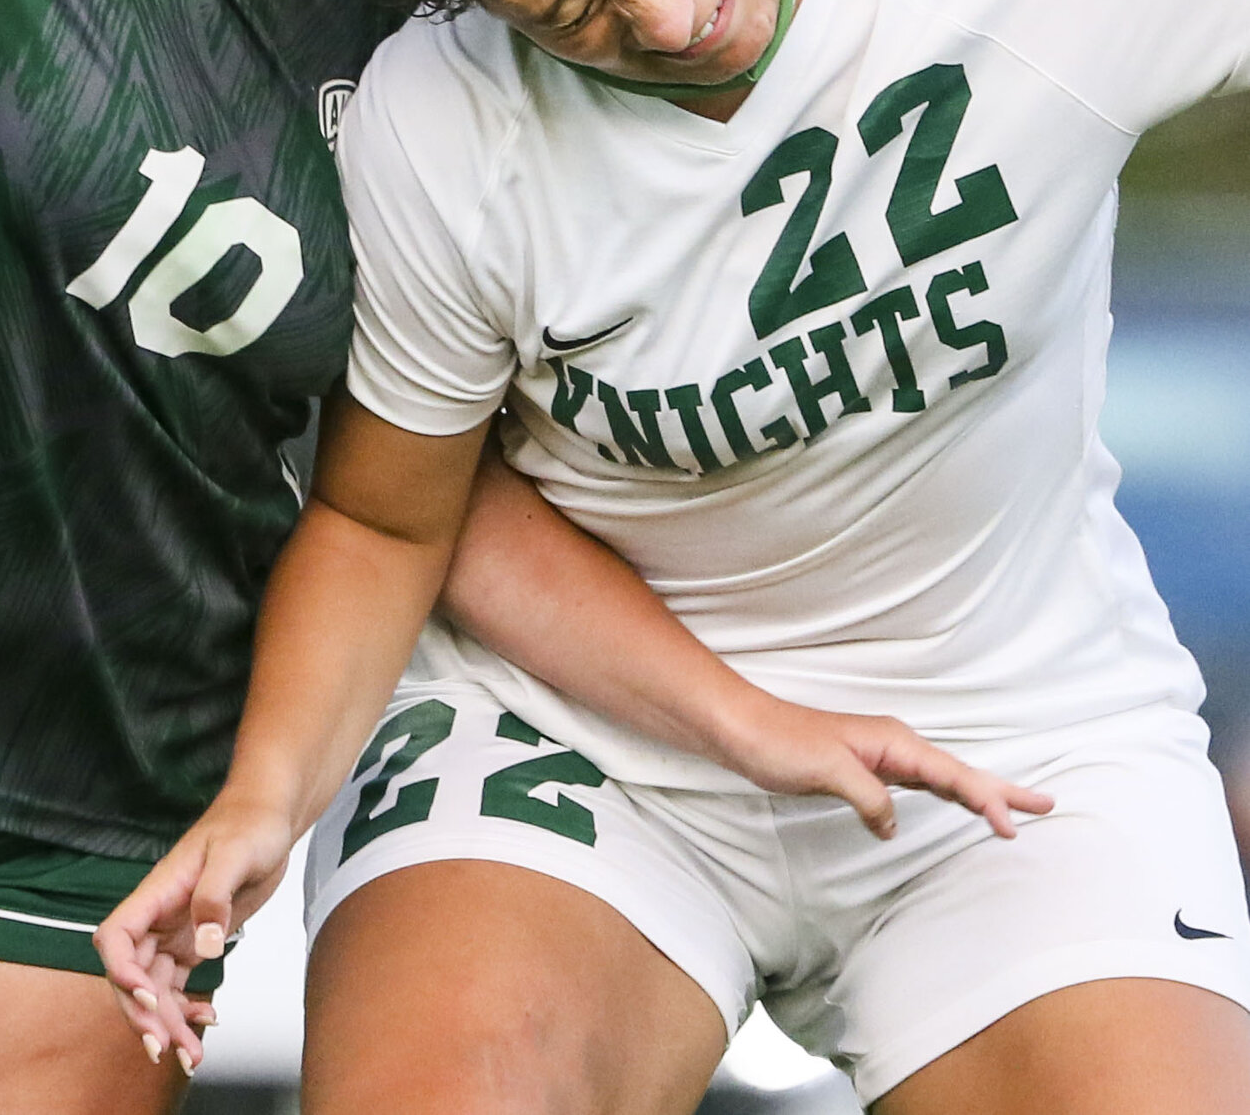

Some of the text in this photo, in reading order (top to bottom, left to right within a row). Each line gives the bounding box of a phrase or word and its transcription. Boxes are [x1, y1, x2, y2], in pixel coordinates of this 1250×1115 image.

[66, 145, 305, 358] 10
[742, 64, 1019, 340] 22
[546, 260, 1008, 477] KNIGHTS
[338, 699, 607, 868] 22
